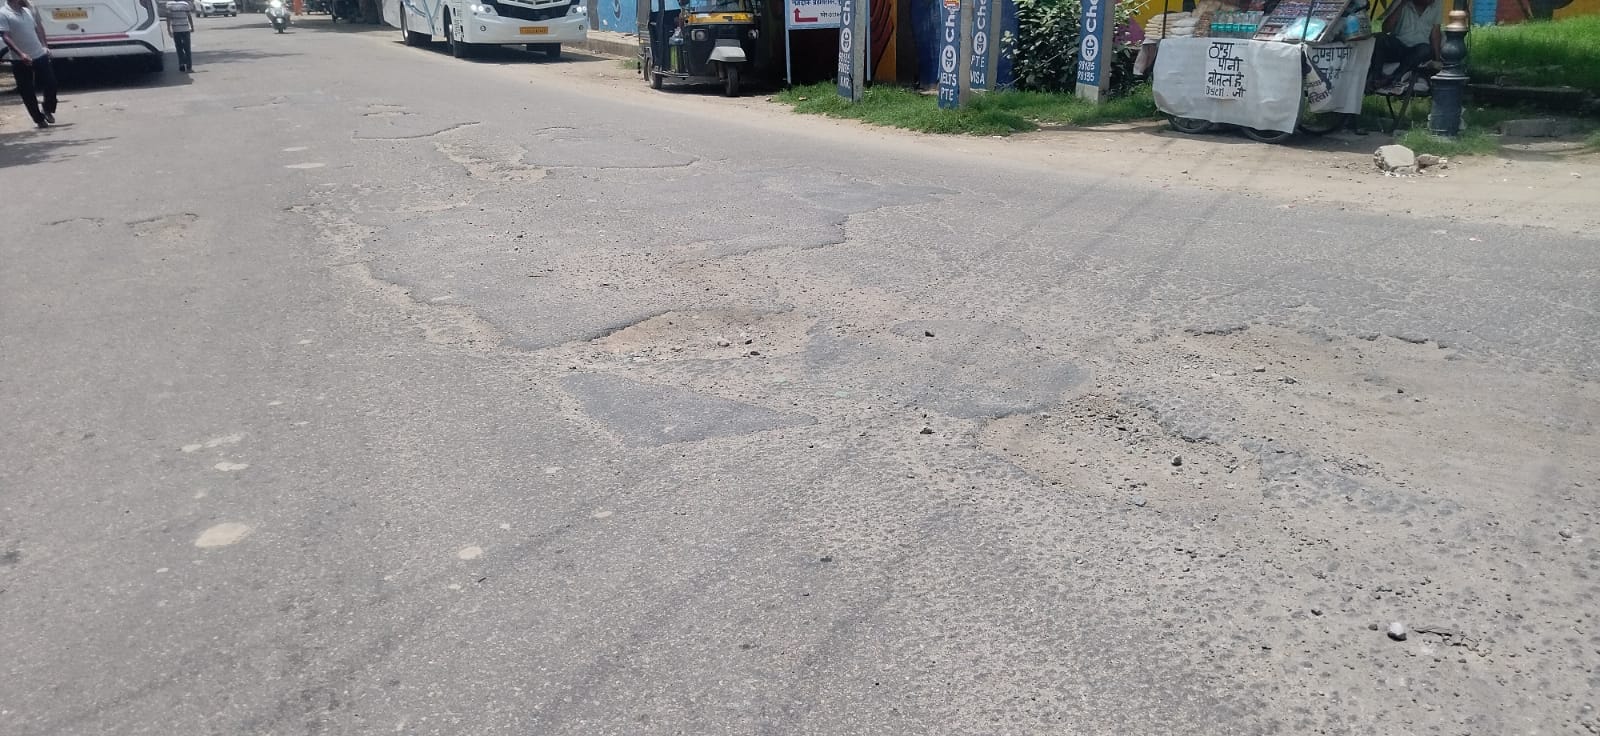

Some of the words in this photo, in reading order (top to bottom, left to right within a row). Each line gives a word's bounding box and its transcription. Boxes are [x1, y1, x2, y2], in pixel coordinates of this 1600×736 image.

[970, 56, 984, 68] PTE
[1218, 56, 1244, 72] पानी
[940, 72, 956, 86] IELTS
[970, 71, 984, 84] VISA
[940, 87, 954, 100] PTE
